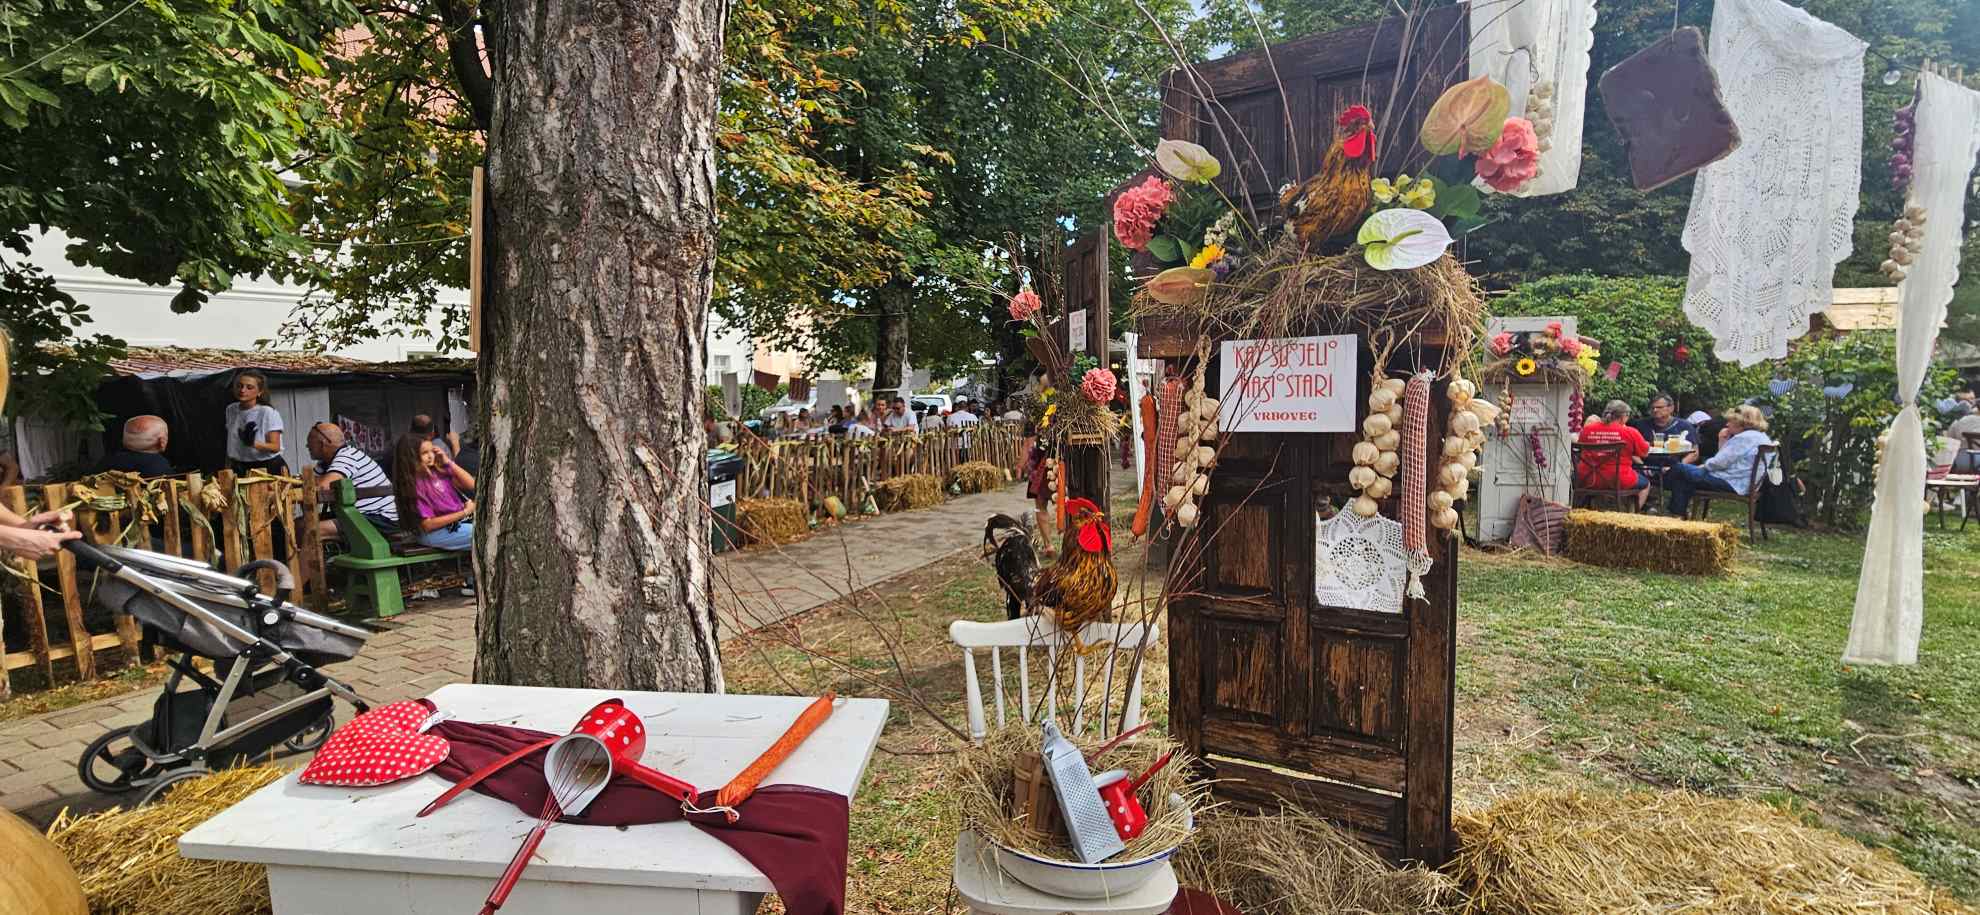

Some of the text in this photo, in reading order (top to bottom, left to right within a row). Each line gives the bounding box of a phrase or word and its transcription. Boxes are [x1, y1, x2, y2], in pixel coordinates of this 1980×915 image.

[1298, 342, 1327, 367] JELI
[1284, 373, 1333, 398] STARI
[1253, 411, 1317, 421] VRBOVEC
